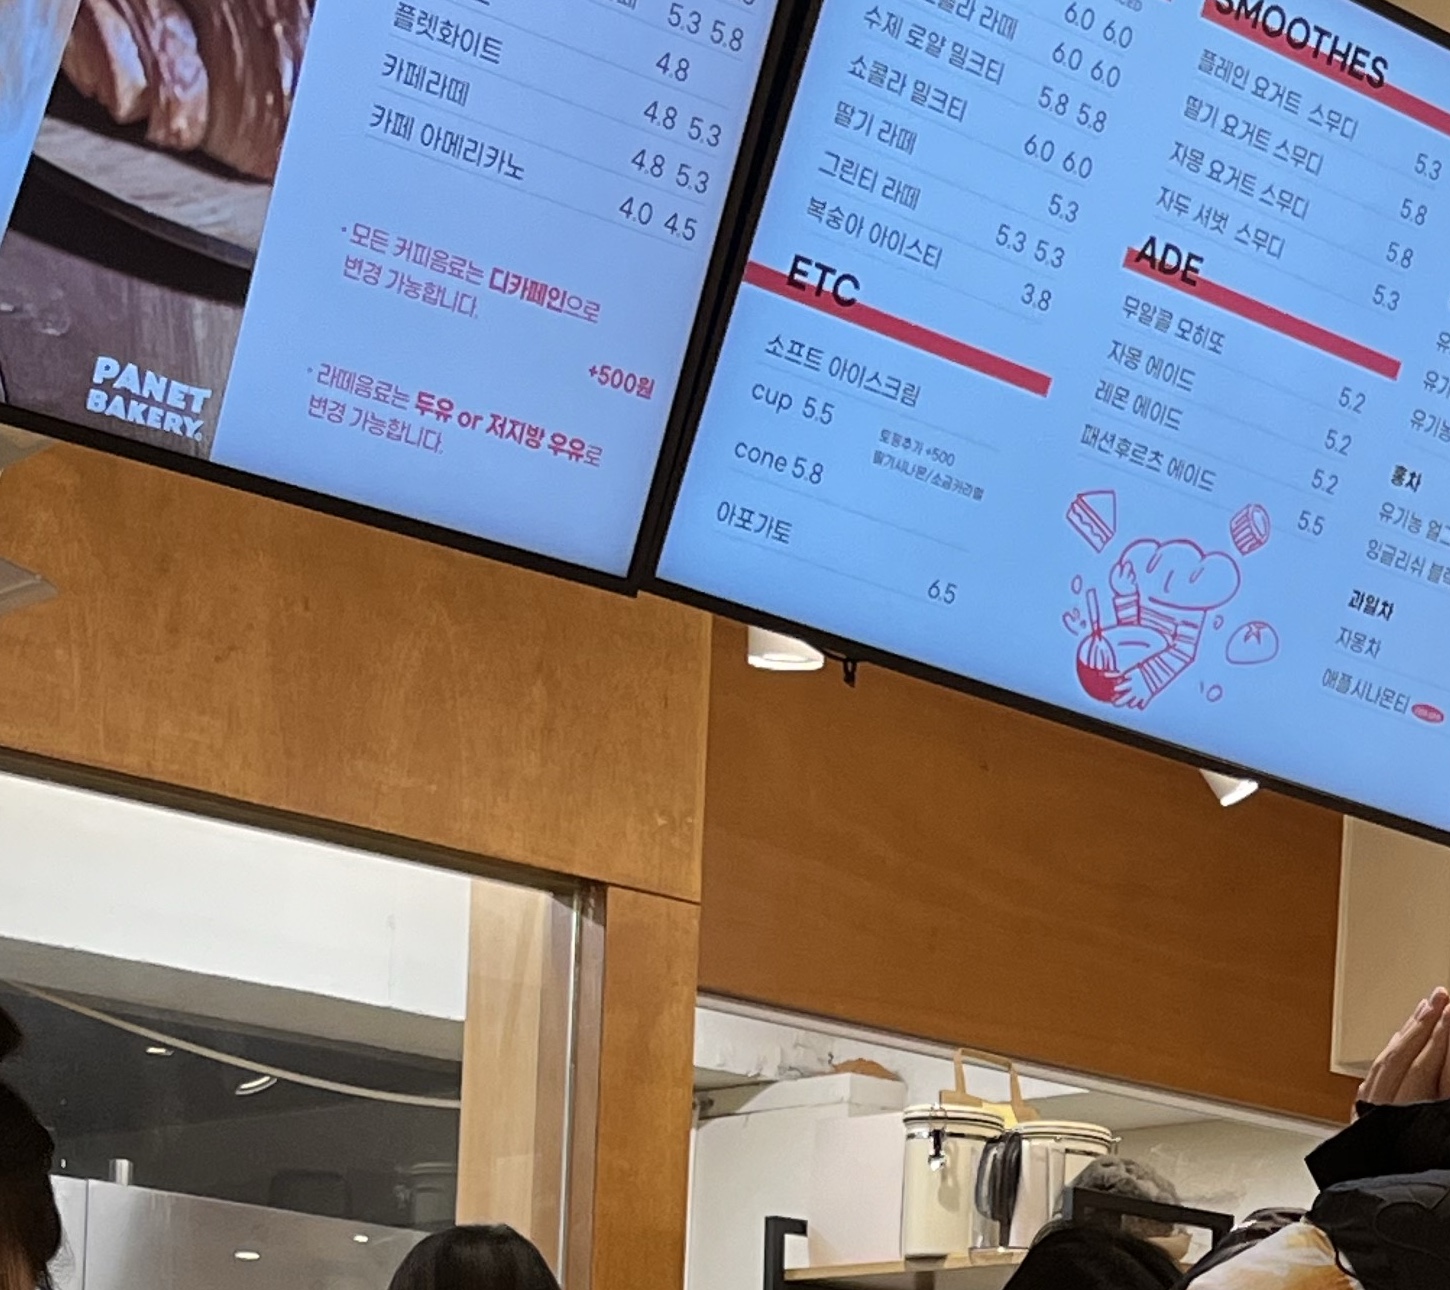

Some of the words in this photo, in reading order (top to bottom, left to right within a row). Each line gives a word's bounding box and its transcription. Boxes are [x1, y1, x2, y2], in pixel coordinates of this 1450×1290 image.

[656, 52, 689, 81] 4.8
[668, 3, 701, 35] 5.3
[711, 19, 744, 52] 5.8
[979, 6, 1018, 41] 라떼
[1052, 42, 1083, 70] 6.0
[1091, 60, 1120, 87] 6.0
[1065, 2, 1095, 30] 6.0
[1103, 20, 1132, 48] 6.0
[1216, 0, 1388, 88] SMOOTHES
[394, 2, 503, 64] 플렛화이트
[644, 101, 677, 130] 4.8
[688, 117, 721, 147] 5.3
[864, 6, 903, 39] 수제
[905, 23, 946, 58] 로얄
[949, 42, 1005, 85] 밀크티
[1038, 85, 1069, 116] 5.8
[1077, 102, 1107, 133] 5.8
[382, 54, 470, 107] 카페라떼
[631, 149, 665, 177] 4.8
[676, 163, 709, 193] 5.3
[847, 55, 907, 96] 쇼콜라
[911, 79, 967, 123] 밀크티
[1024, 134, 1054, 162] 6.0
[1063, 151, 1092, 179] 6.0
[1198, 49, 1250, 90] 플레인
[1251, 76, 1302, 115] 요거트
[1308, 104, 1358, 142] 스무디
[1414, 153, 1442, 180] 5.3
[370, 104, 414, 141] 카페
[421, 123, 524, 180] 아메리카노
[619, 197, 653, 225] 4.0
[664, 213, 697, 241] 4.5
[834, 101, 874, 136] 딸기
[877, 120, 917, 155] 라떼
[1048, 193, 1079, 223] 5.3
[1184, 95, 1219, 128] 딸기
[1220, 114, 1272, 152] 요거트
[1273, 139, 1324, 176] 스무디
[1400, 198, 1427, 226] 5.8
[818, 151, 878, 193] 그린티
[881, 176, 921, 210] 라떼
[996, 223, 1026, 252] 5.3
[1034, 240, 1065, 268] 5.3
[1169, 141, 1204, 173] 자몽
[1206, 159, 1257, 197] 요거트
[1259, 184, 1310, 220] 스무디
[1386, 242, 1413, 269] 5.8
[343, 255, 382, 285] 변경
[350, 223, 389, 254] 모든
[393, 237, 484, 285] 커피음료는
[489, 267, 600, 323] 디카페인으로
[787, 254, 860, 306] ETC
[807, 196, 864, 238] 복숭아
[869, 222, 942, 270] 아이스티
[1021, 283, 1051, 311] 3.8
[1136, 236, 1204, 286] ADE
[1156, 186, 1191, 216] 자두
[1234, 223, 1285, 259] 스무디
[1372, 284, 1400, 311] 5.3
[93, 356, 212, 413] PANET
[589, 365, 655, 399] +500원
[765, 334, 824, 371] 소프트
[829, 356, 921, 407] 아이스크림
[1123, 295, 1173, 333] 무알콜
[1175, 318, 1225, 355] 모히또
[1339, 386, 1365, 414] 5.2
[308, 395, 346, 423] 변경
[317, 363, 409, 410] 라떼음료는
[415, 391, 454, 423] 두유
[458, 411, 483, 430] or
[486, 413, 545, 449] 저지방
[548, 433, 602, 466] 우유로
[752, 384, 792, 414] cup
[803, 396, 834, 424] 5.5
[1095, 379, 1130, 410] 레몬
[1133, 395, 1183, 430] 에이드
[1311, 468, 1338, 495] 5.2
[1107, 340, 1142, 370] 자몽
[1146, 355, 1196, 392] 에이드
[1325, 428, 1352, 456] 5.2
[735, 442, 787, 472] cone
[792, 456, 823, 484] 5.8
[1167, 457, 1216, 492] 에이드
[1298, 510, 1325, 536] 5.5
[717, 501, 792, 544] 아포가토
[928, 579, 957, 604] 6.5
[1366, 539, 1426, 577] 잉글리쉬
[1379, 502, 1422, 534] 유기농
[1335, 627, 1381, 659] 자몽차
[1348, 590, 1394, 621] 과일차
[1322, 668, 1410, 714] 애플시나몬티
